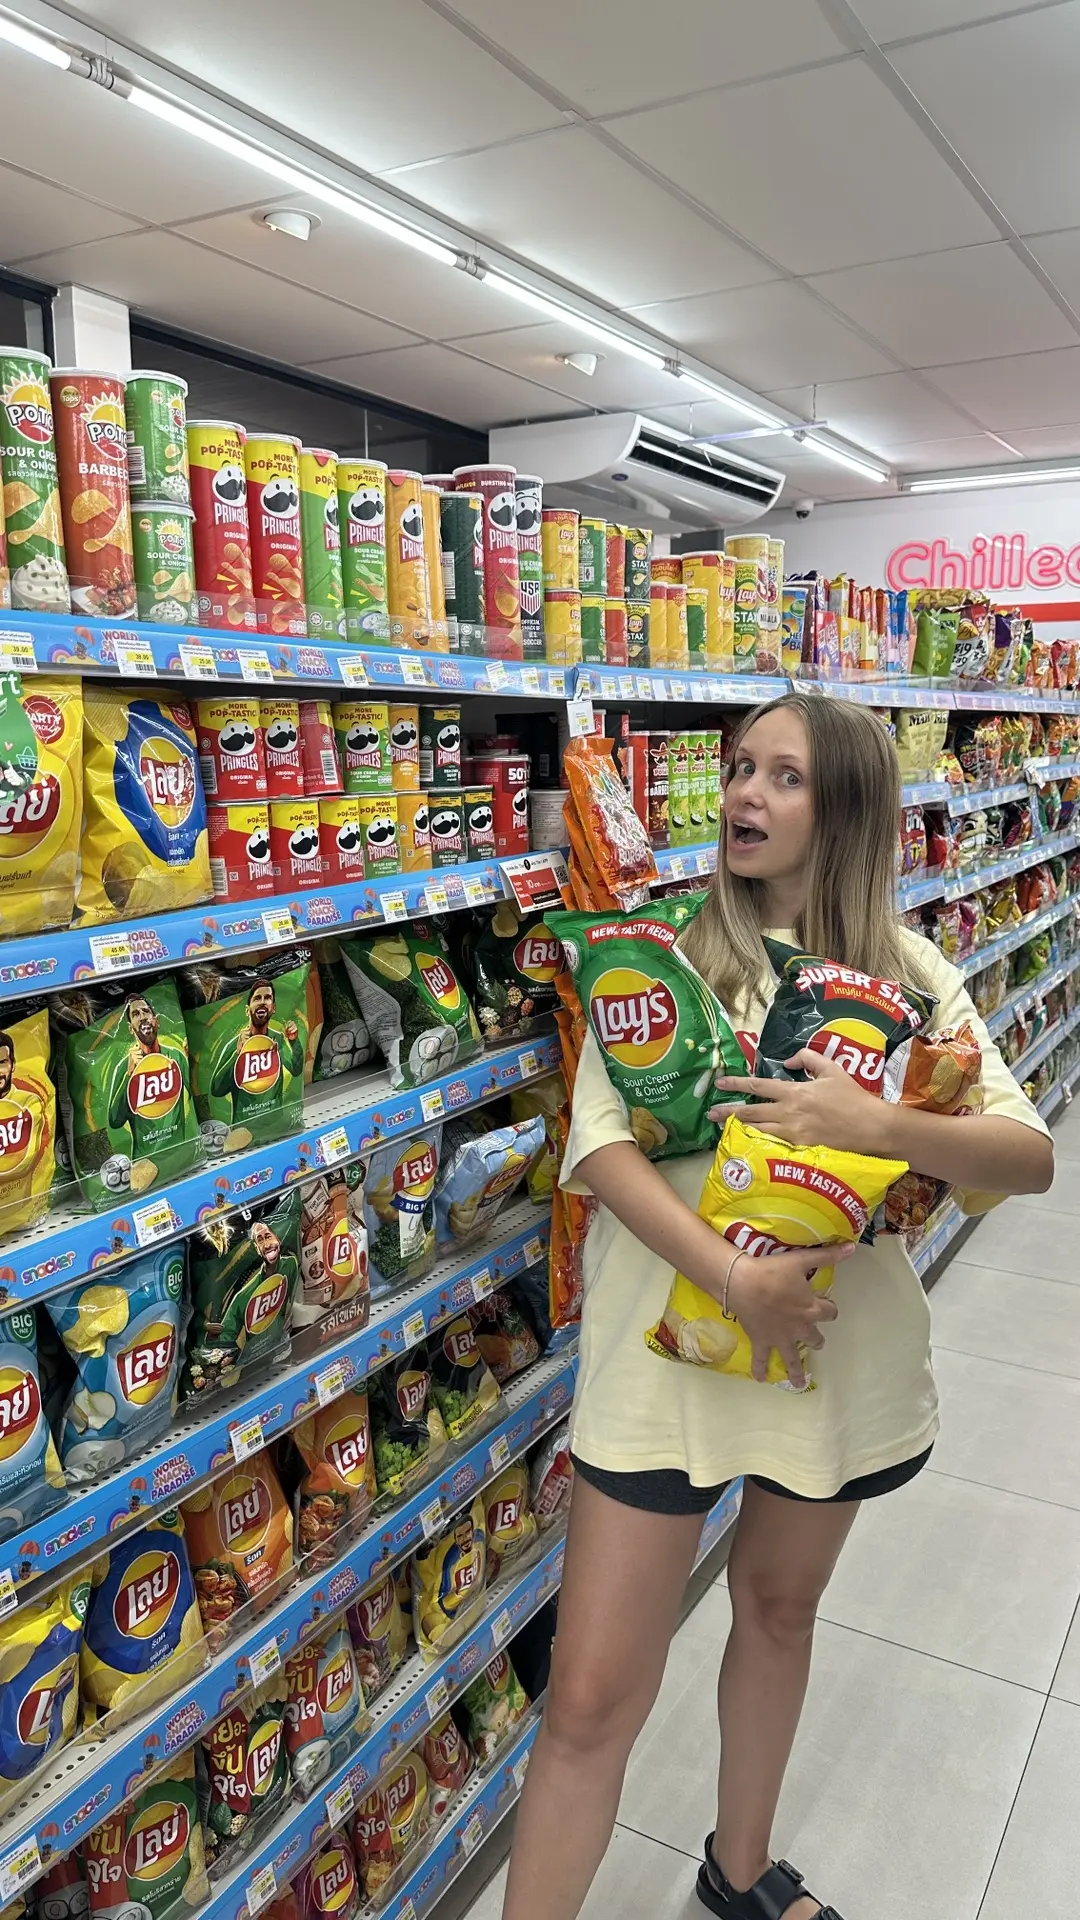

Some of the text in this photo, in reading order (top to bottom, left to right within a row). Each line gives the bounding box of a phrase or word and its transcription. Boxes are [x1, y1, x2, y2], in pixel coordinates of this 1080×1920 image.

[297, 647, 324, 658] WORLD
[297, 656, 328, 668] SNACKS
[296, 665, 334, 677] PARADISE
[220, 753, 259, 773] PRINGLES
[346, 751, 381, 769] PRINGLES
[368, 845, 399, 861] PRINGLES
[431, 835, 462, 851] PRINGLES
[306, 897, 332, 909] WORLD
[306, 905, 337, 918] SNACKS
[306, 911, 343, 927] PARADISE
[620, 923, 648, 937] TASTY
[1, 958, 58, 983] snacker
[794, 966, 923, 1028] SUPER SIZE
[596, 986, 669, 1046] Lay's
[243, 1045, 274, 1082] เลย์
[137, 1063, 174, 1107] เลย์
[623, 1069, 681, 1088] Sour Cream
[635, 1081, 674, 1098] & Onion
[774, 1163, 806, 1185] NEW,
[809, 1171, 846, 1200] TASTY
[405, 1201, 419, 1211] BIG
[21, 1250, 77, 1286] snacker
[167, 1270, 184, 1286] BIG
[11, 1315, 33, 1329] BIG
[126, 1332, 173, 1393] เลย์
[152, 1454, 186, 1478] WORLD
[152, 1462, 191, 1489] SNACKS
[151, 1466, 197, 1501] PARADISE
[45, 1515, 97, 1557] snacker
[127, 1558, 171, 1630] เลย์
[165, 1700, 197, 1731] WORLD
[166, 1708, 201, 1743] SNACKS
[164, 1712, 208, 1754] PARADISE
[63, 1783, 113, 1836] snacker
[136, 1810, 181, 1872] เลย์
